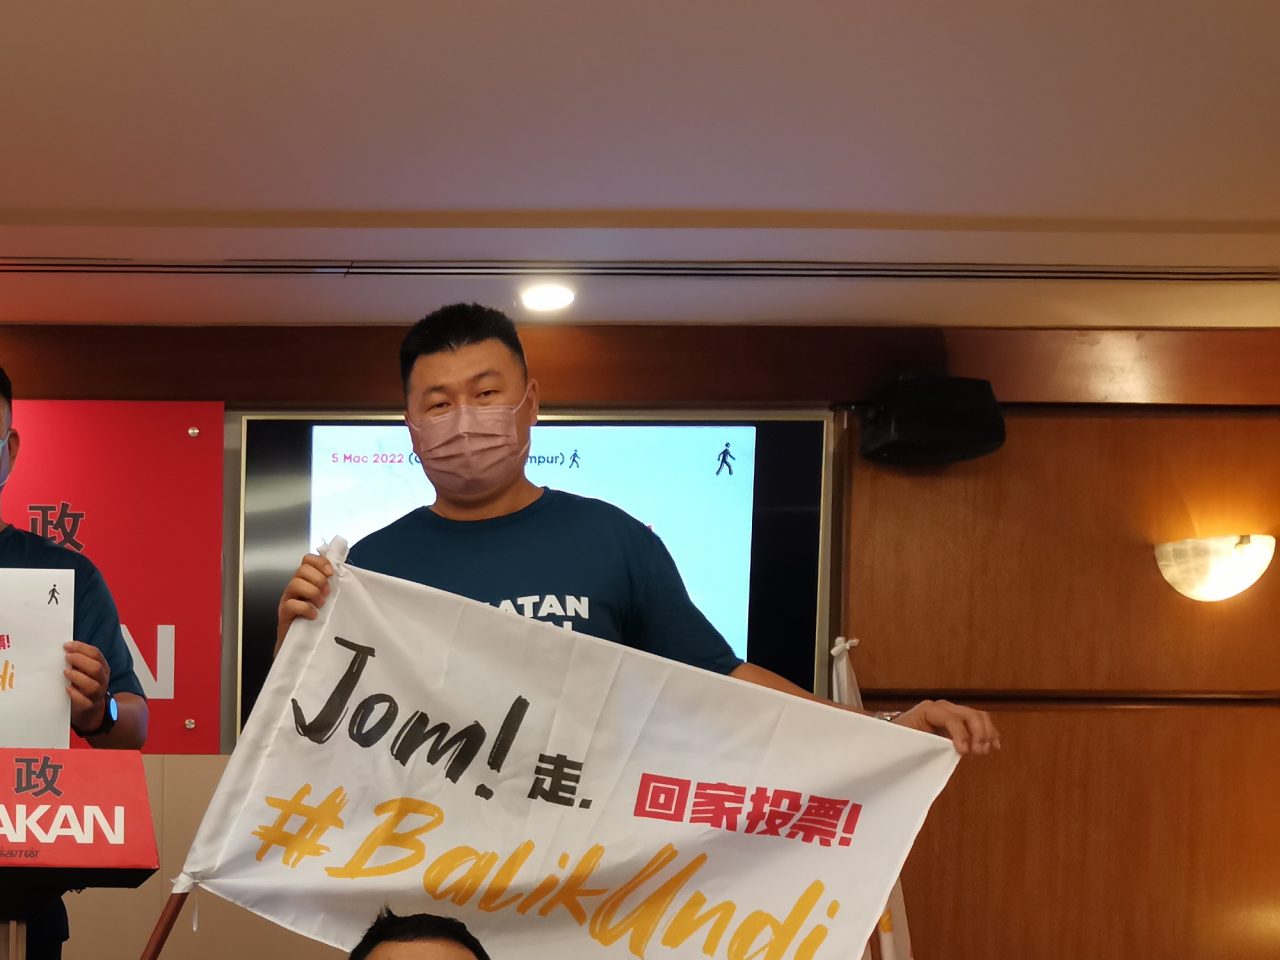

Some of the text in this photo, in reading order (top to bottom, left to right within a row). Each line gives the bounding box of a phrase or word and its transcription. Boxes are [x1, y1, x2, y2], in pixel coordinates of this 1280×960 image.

[331, 453, 339, 463] 5
[343, 453, 369, 463] Mac
[373, 453, 404, 463] 2022
[27, 501, 86, 552] 政
[291, 635, 531, 801] Jom!
[634, 772, 861, 848] 回家投票!
